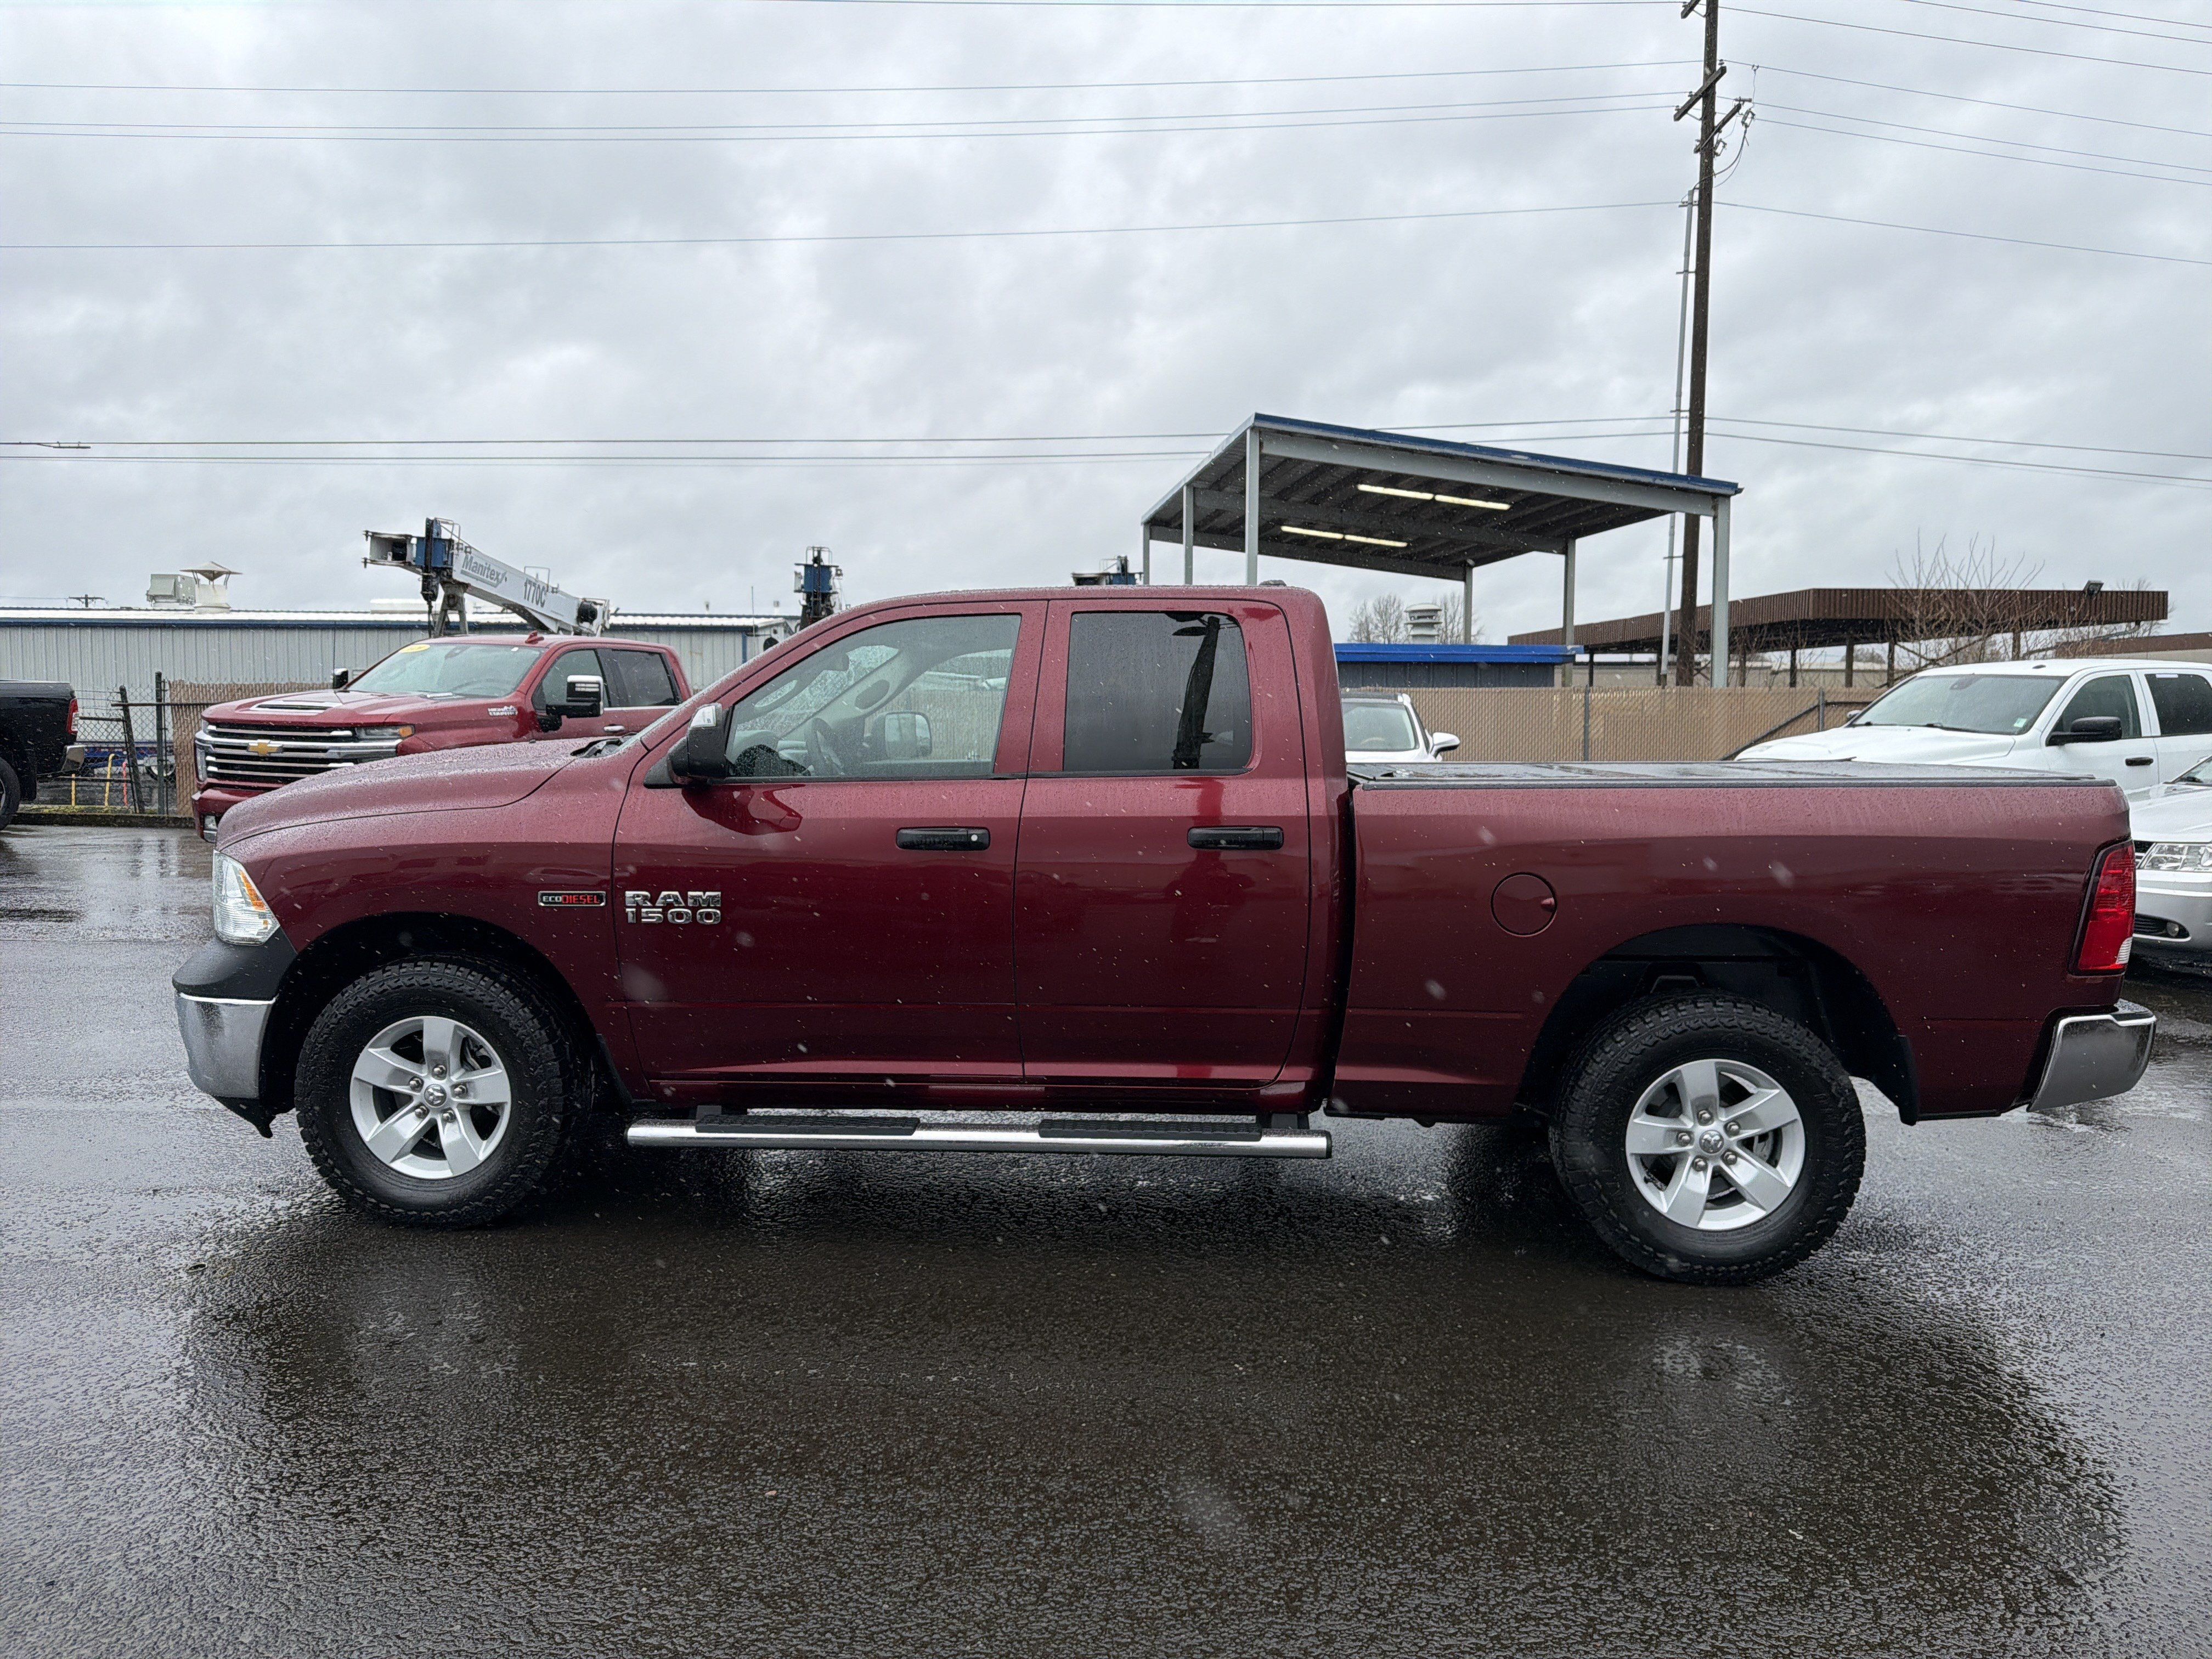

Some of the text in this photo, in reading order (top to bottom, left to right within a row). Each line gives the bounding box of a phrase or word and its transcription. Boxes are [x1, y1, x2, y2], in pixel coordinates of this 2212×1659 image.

[462, 554, 501, 583] Manitex
[524, 578, 546, 608] 1770C
[542, 895, 600, 904] ECODIESEL
[625, 891, 721, 907] RAM
[626, 908, 721, 924] 1500
